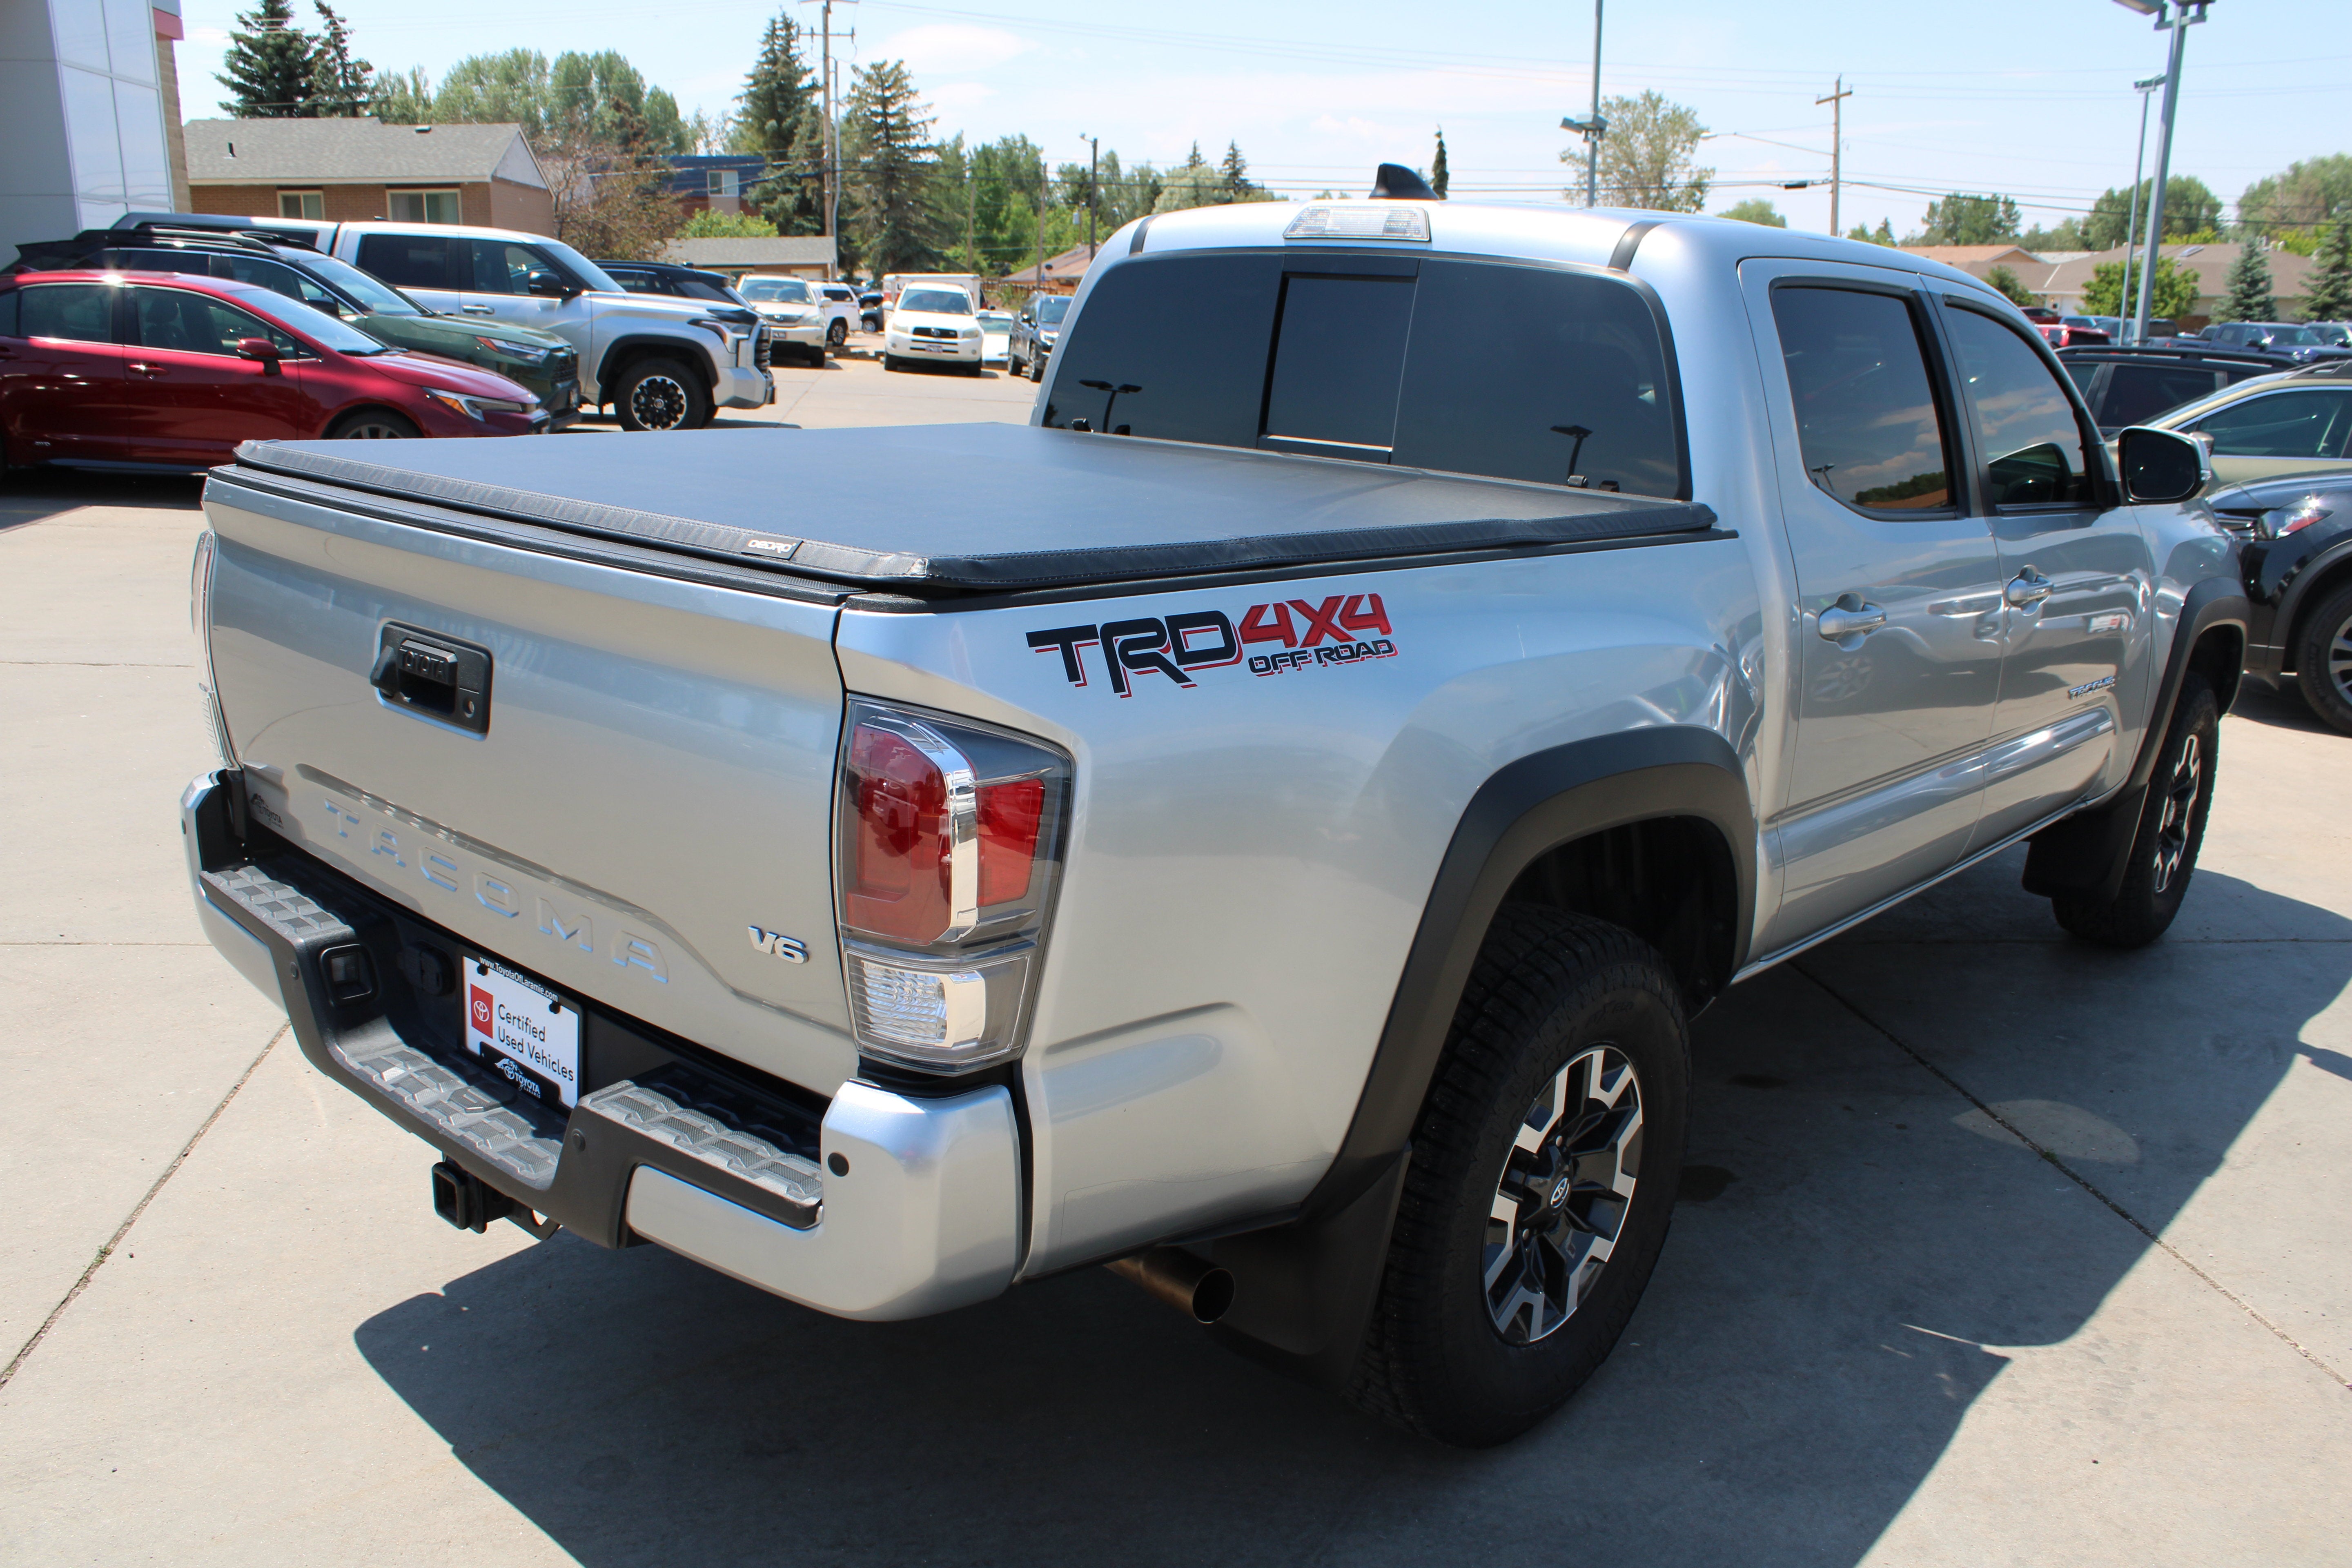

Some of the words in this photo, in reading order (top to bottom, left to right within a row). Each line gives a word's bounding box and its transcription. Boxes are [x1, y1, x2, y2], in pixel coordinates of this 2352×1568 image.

[399, 647, 445, 678] TOYOTA
[1025, 610, 1243, 699] TRD
[1247, 648, 1312, 677] OFF
[1316, 640, 1399, 668] ROAD
[325, 797, 669, 984] TACOMA
[748, 925, 809, 965] V6
[479, 956, 559, 1002] www.ToyotaOfLaramie.com
[498, 1003, 546, 1042] Certified
[498, 1025, 524, 1054] Used
[527, 1042, 574, 1081] Vehicles
[514, 1071, 541, 1095] TOYOTA
